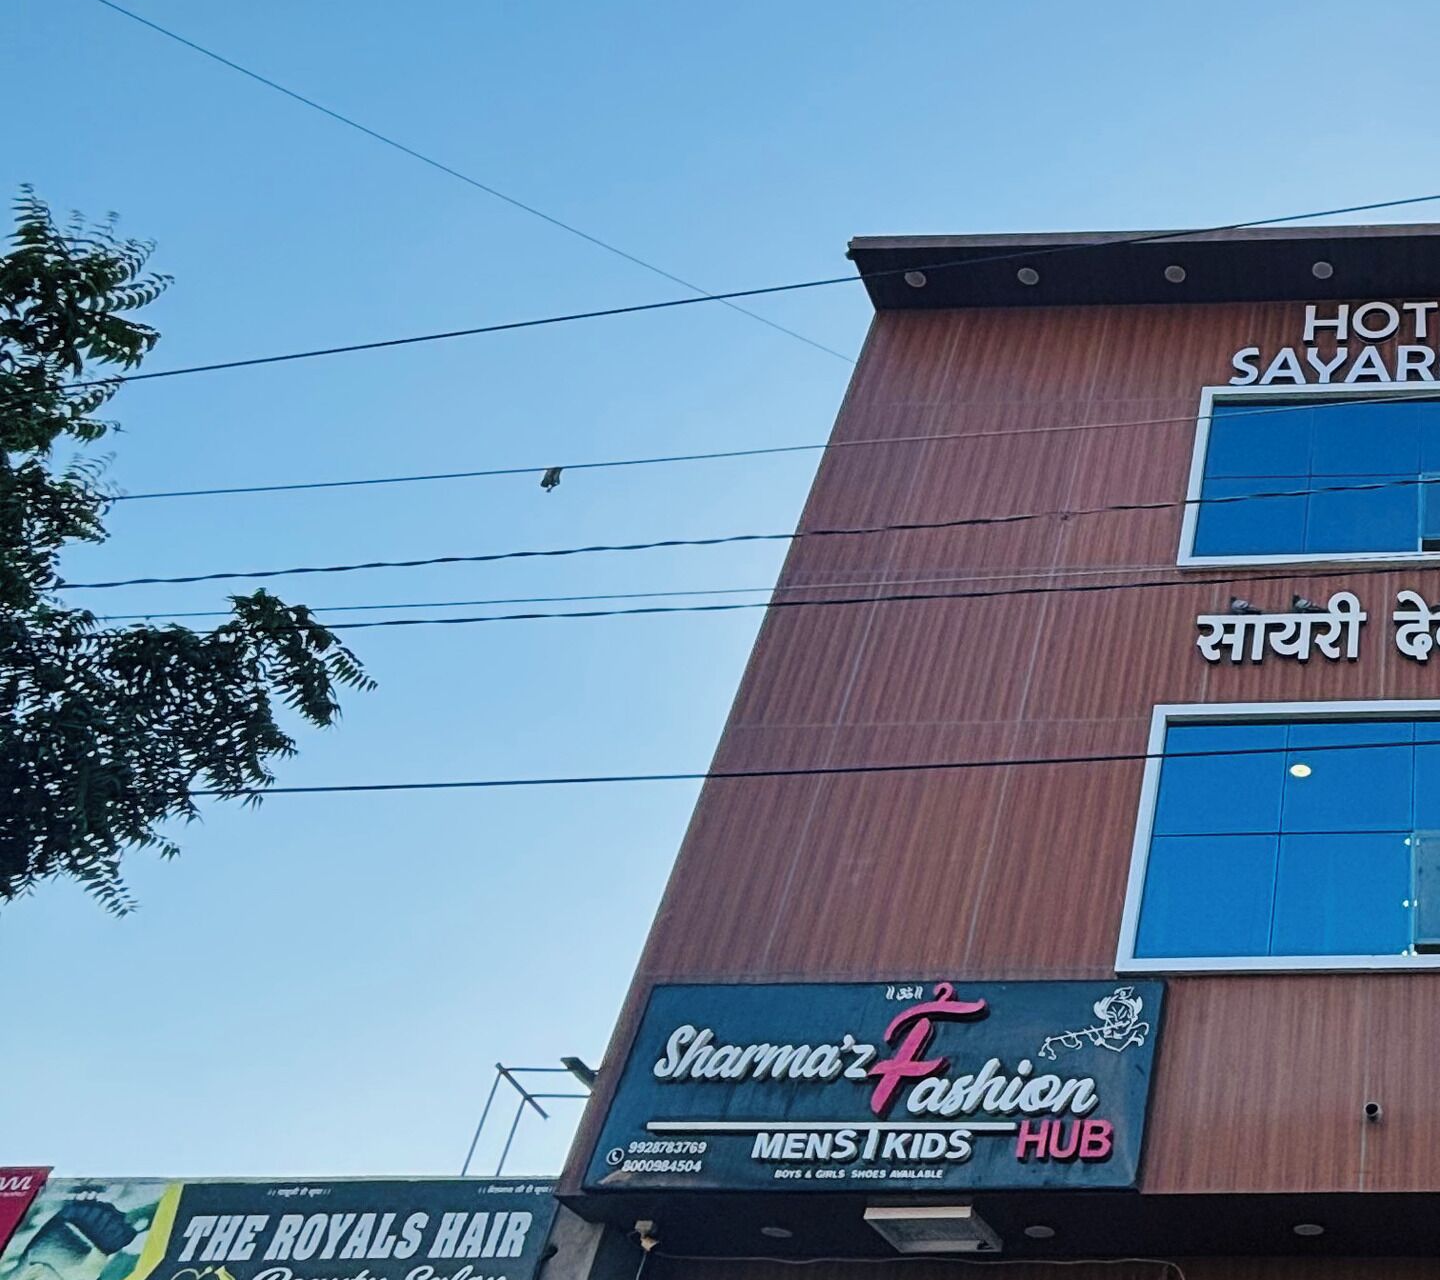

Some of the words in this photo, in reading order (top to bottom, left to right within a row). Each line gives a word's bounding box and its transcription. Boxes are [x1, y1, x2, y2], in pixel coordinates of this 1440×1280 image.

[1197, 591, 1367, 663] सायरी
[868, 982, 1100, 1119] Fashion
[628, 1141, 707, 1154] 9928783769
[751, 1128, 859, 1162] MENS
[882, 1128, 973, 1163] KIDS
[1015, 1120, 1114, 1162] HUB
[774, 1169, 802, 1179] BOYS
[815, 1169, 846, 1179] GIRLS
[851, 1169, 887, 1179] SHOES
[889, 1169, 944, 1179] AVAILABLE
[178, 1214, 269, 1262] THE
[263, 1211, 430, 1261] ROYALS
[427, 1211, 533, 1259] HAIR
